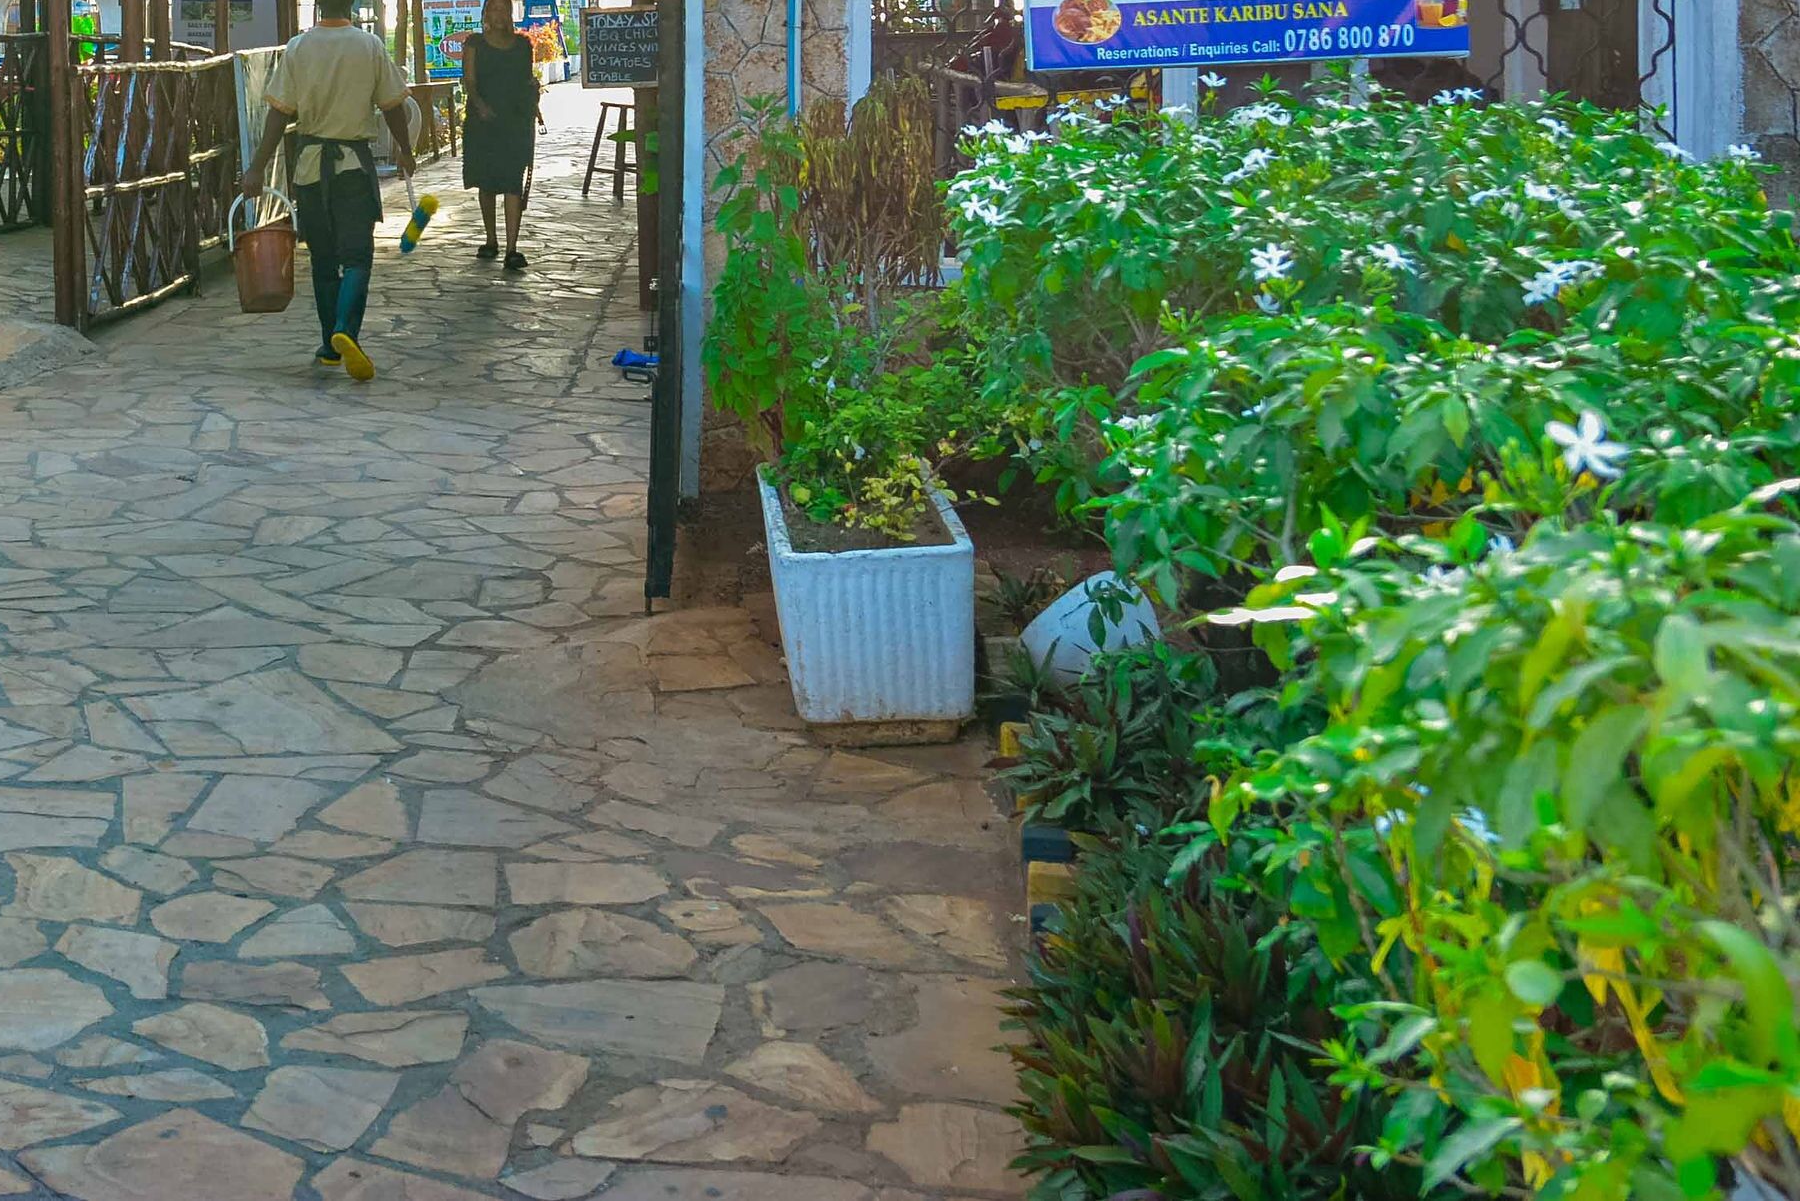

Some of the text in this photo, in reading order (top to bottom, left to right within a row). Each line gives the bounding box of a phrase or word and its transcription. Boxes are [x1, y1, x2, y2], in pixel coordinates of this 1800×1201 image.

[1133, 0, 1348, 26] ASANTE KARIBU SANA
[588, 42, 636, 53] WINGS
[1097, 45, 1179, 60] Reservations
[1189, 41, 1248, 58] Enquiries
[1252, 39, 1281, 54] Call:
[1284, 27, 1333, 52] 0786
[1337, 25, 1373, 50] 800
[1378, 23, 1415, 47] 870
[590, 54, 651, 68] POTATOES
